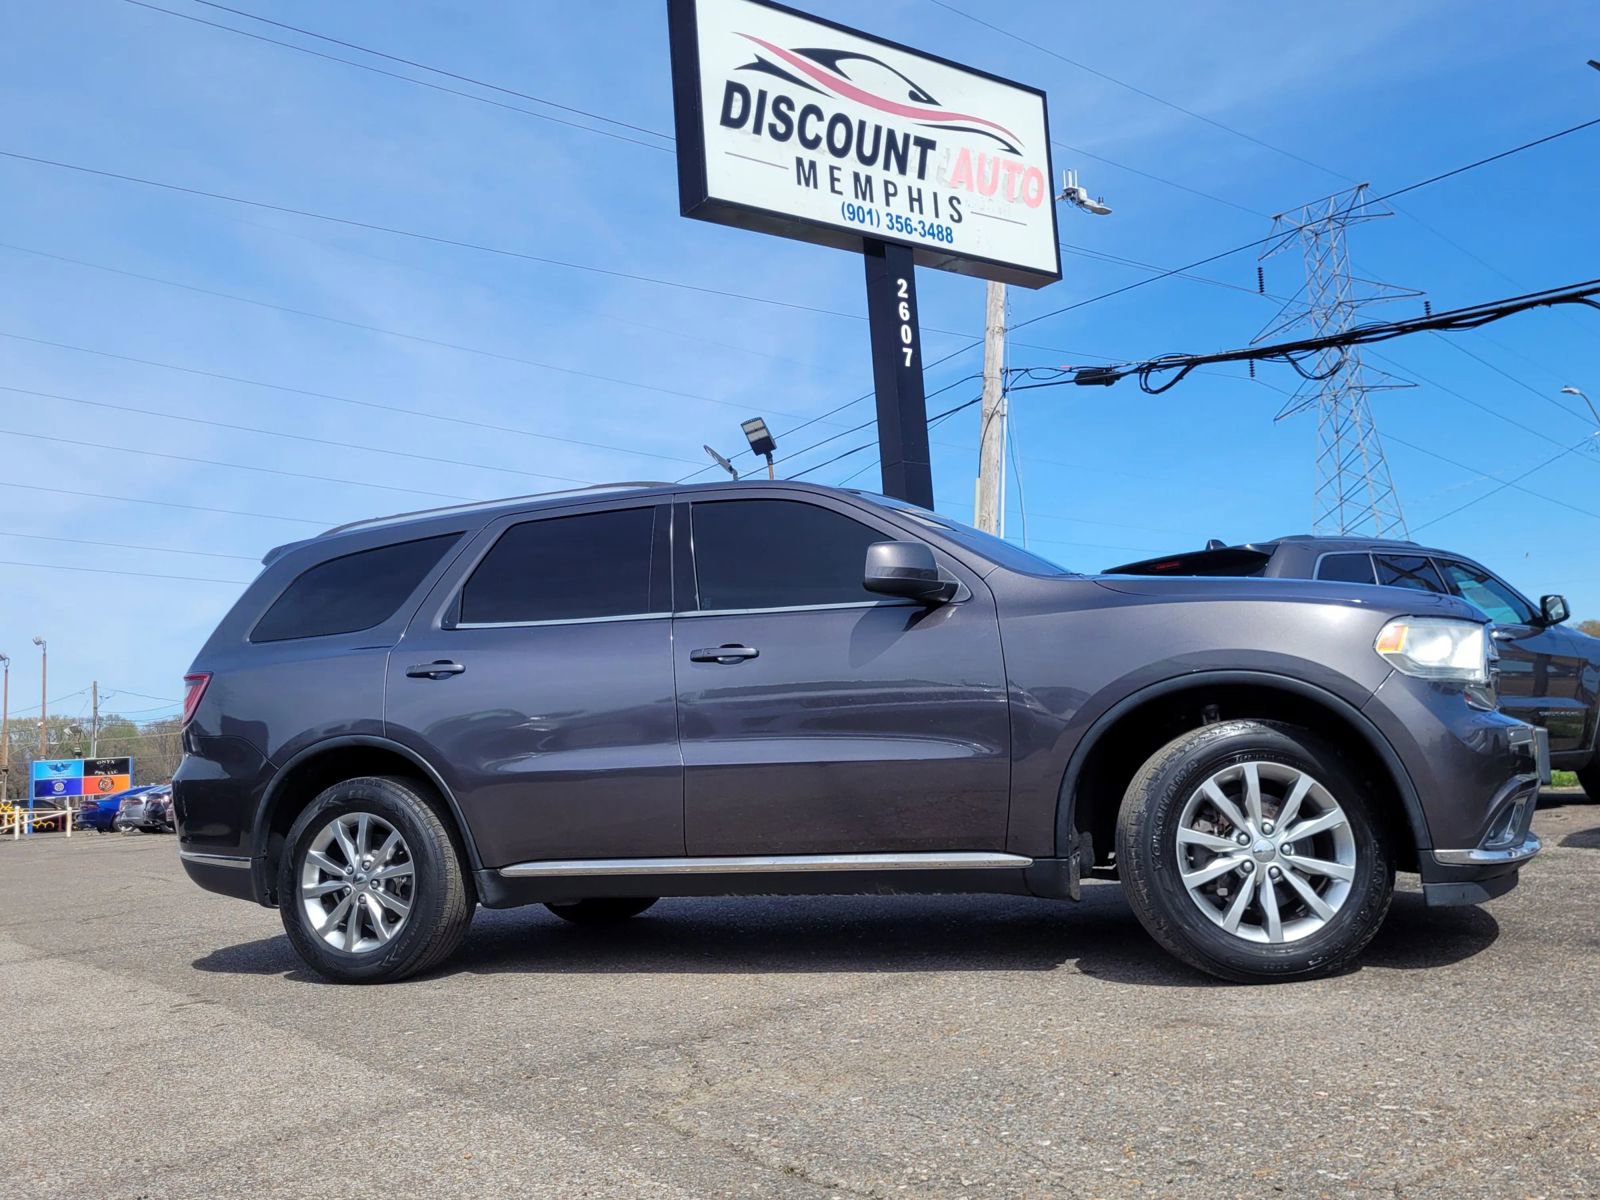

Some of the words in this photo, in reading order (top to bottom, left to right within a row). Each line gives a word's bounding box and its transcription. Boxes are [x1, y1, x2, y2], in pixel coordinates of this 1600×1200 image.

[720, 80, 937, 181] DISCOUNT
[949, 147, 1045, 209] AUTO
[796, 156, 963, 224] MEMPHIS
[841, 201, 881, 228] (901)
[885, 212, 954, 244] 356-3488
[896, 279, 913, 368] 2607
[1151, 758, 1199, 872] YOKOHAMA
